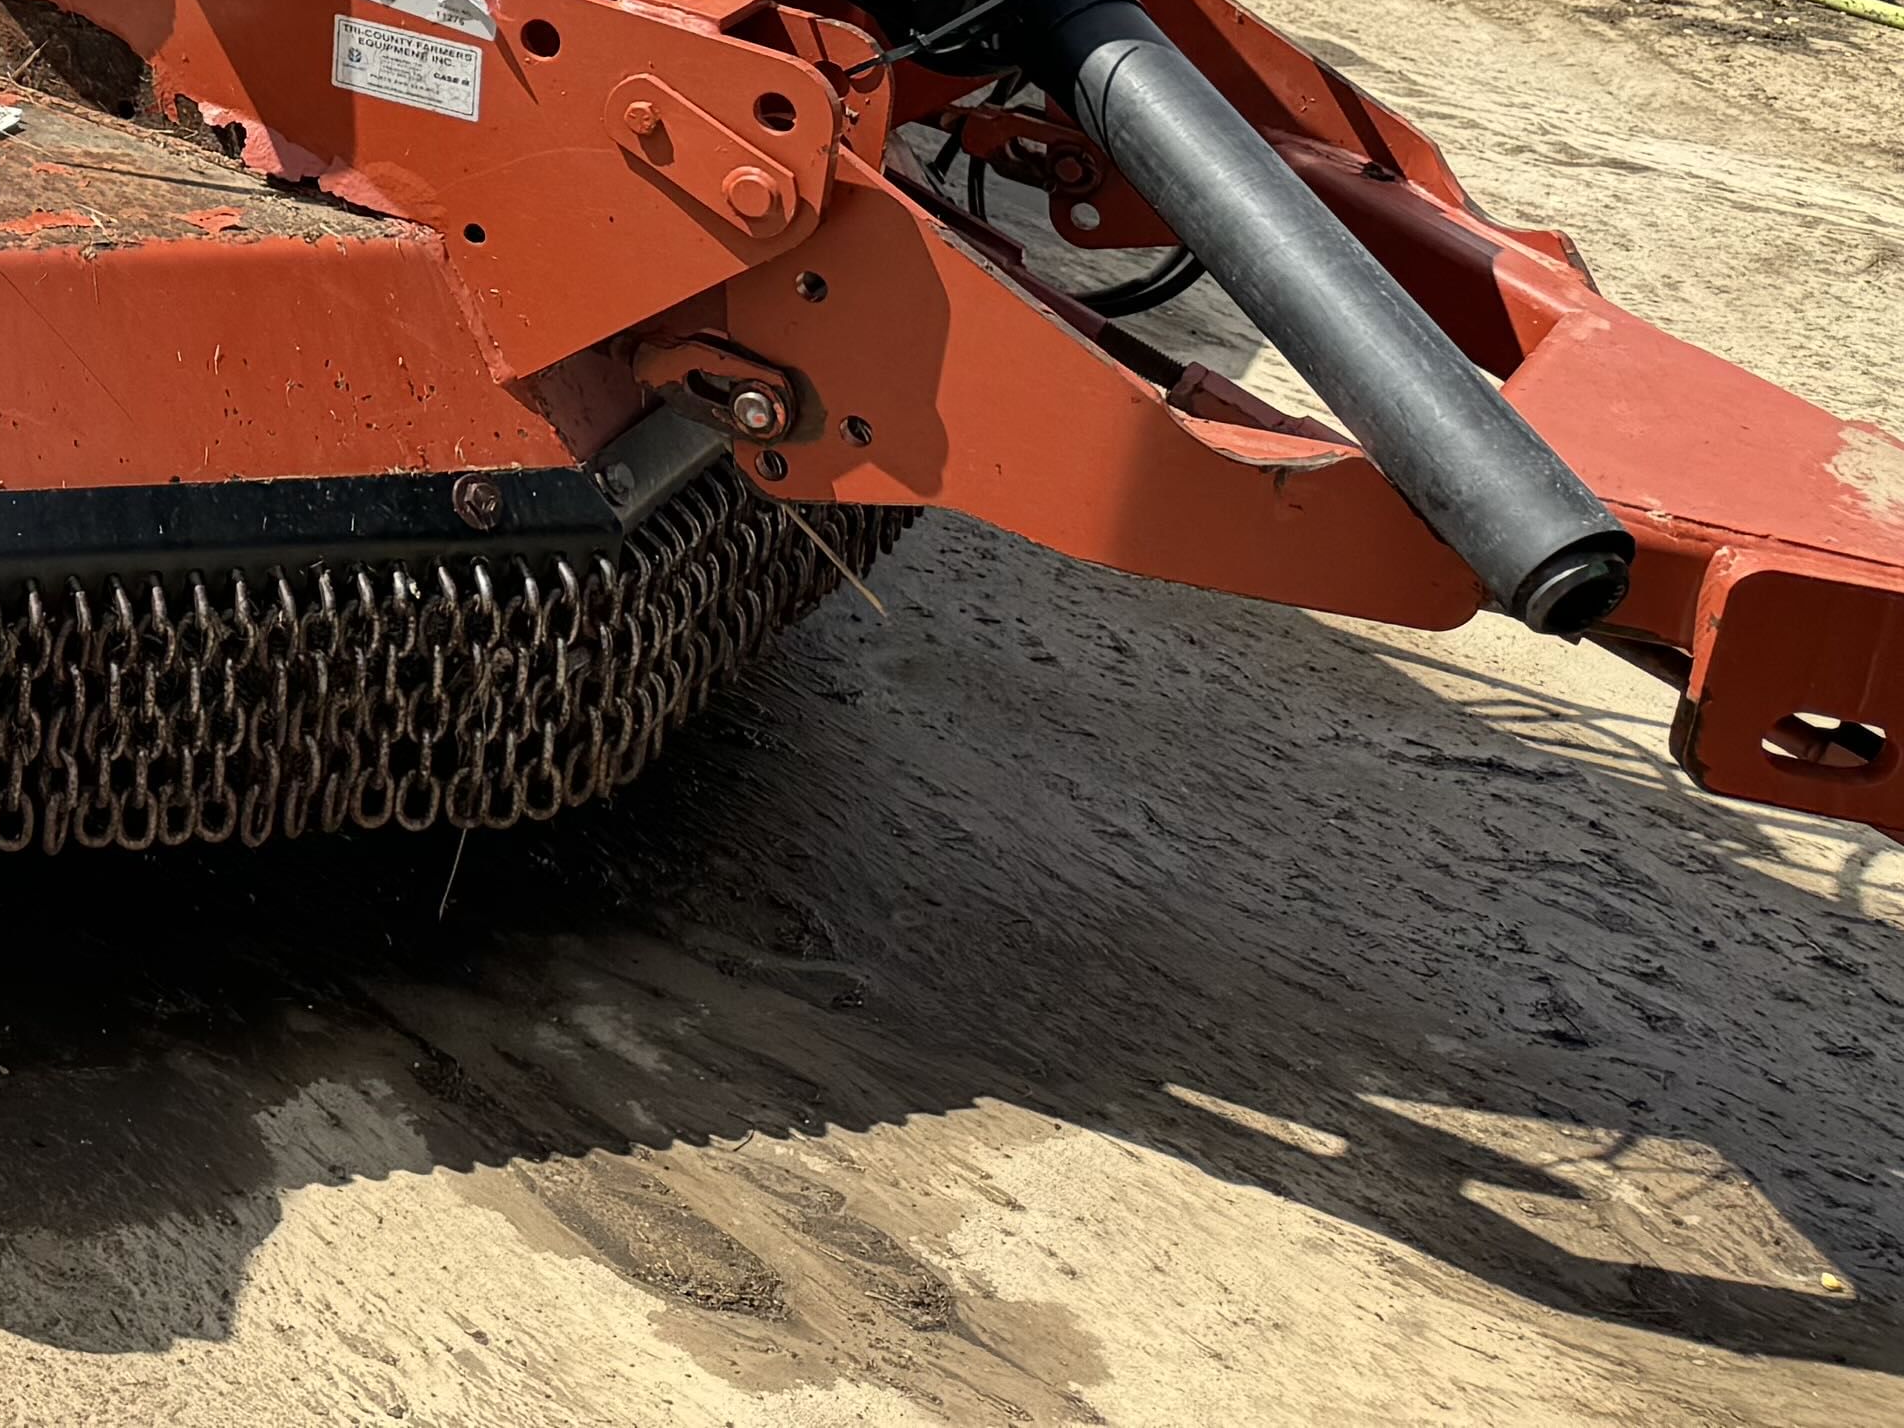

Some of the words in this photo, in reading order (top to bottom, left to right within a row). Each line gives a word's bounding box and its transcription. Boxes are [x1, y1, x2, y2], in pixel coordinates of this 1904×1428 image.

[343, 23, 413, 47] TRI-COUNTY
[416, 40, 473, 62] FARMERS
[358, 36, 429, 63] EQUIPMENT
